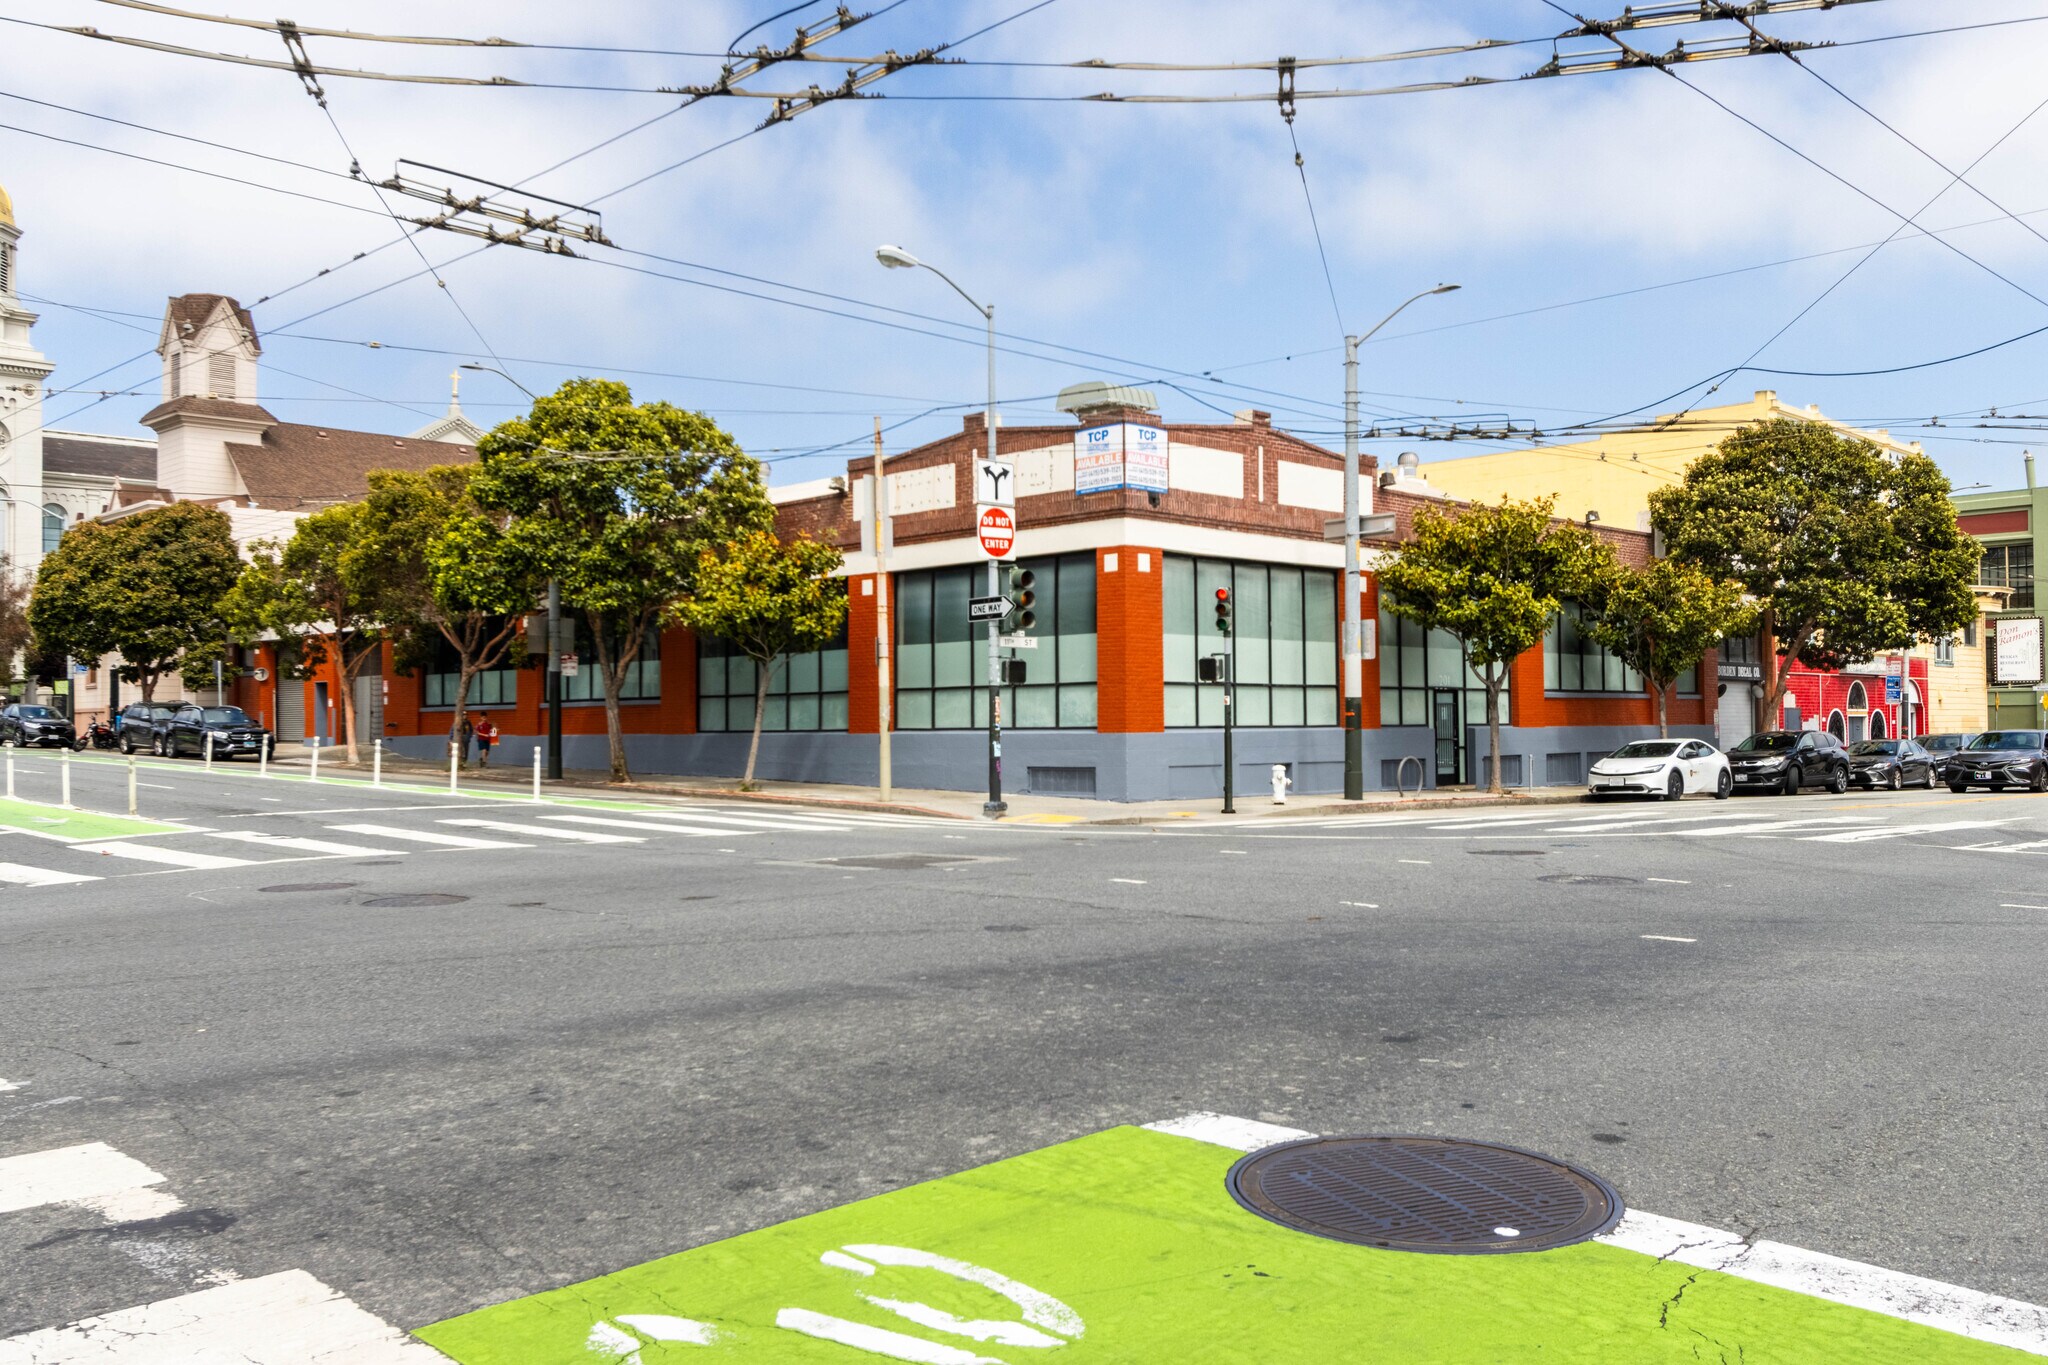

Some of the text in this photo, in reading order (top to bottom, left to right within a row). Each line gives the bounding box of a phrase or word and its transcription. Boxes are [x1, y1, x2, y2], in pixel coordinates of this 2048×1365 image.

[1088, 430, 1109, 442] TCP
[1138, 429, 1156, 441] TCP
[1076, 453, 1122, 470] AVAILABLE
[1126, 452, 1167, 468] AVAILABLE
[982, 516, 1009, 526] DO NOT
[984, 539, 1009, 549] ENTER
[973, 604, 1001, 614] ONE WAY
[2000, 626, 2018, 638] Don
[2000, 627, 2038, 645] Ramon's
[1718, 666, 1736, 676] BORDEN
[1738, 667, 1752, 677] DECAL
